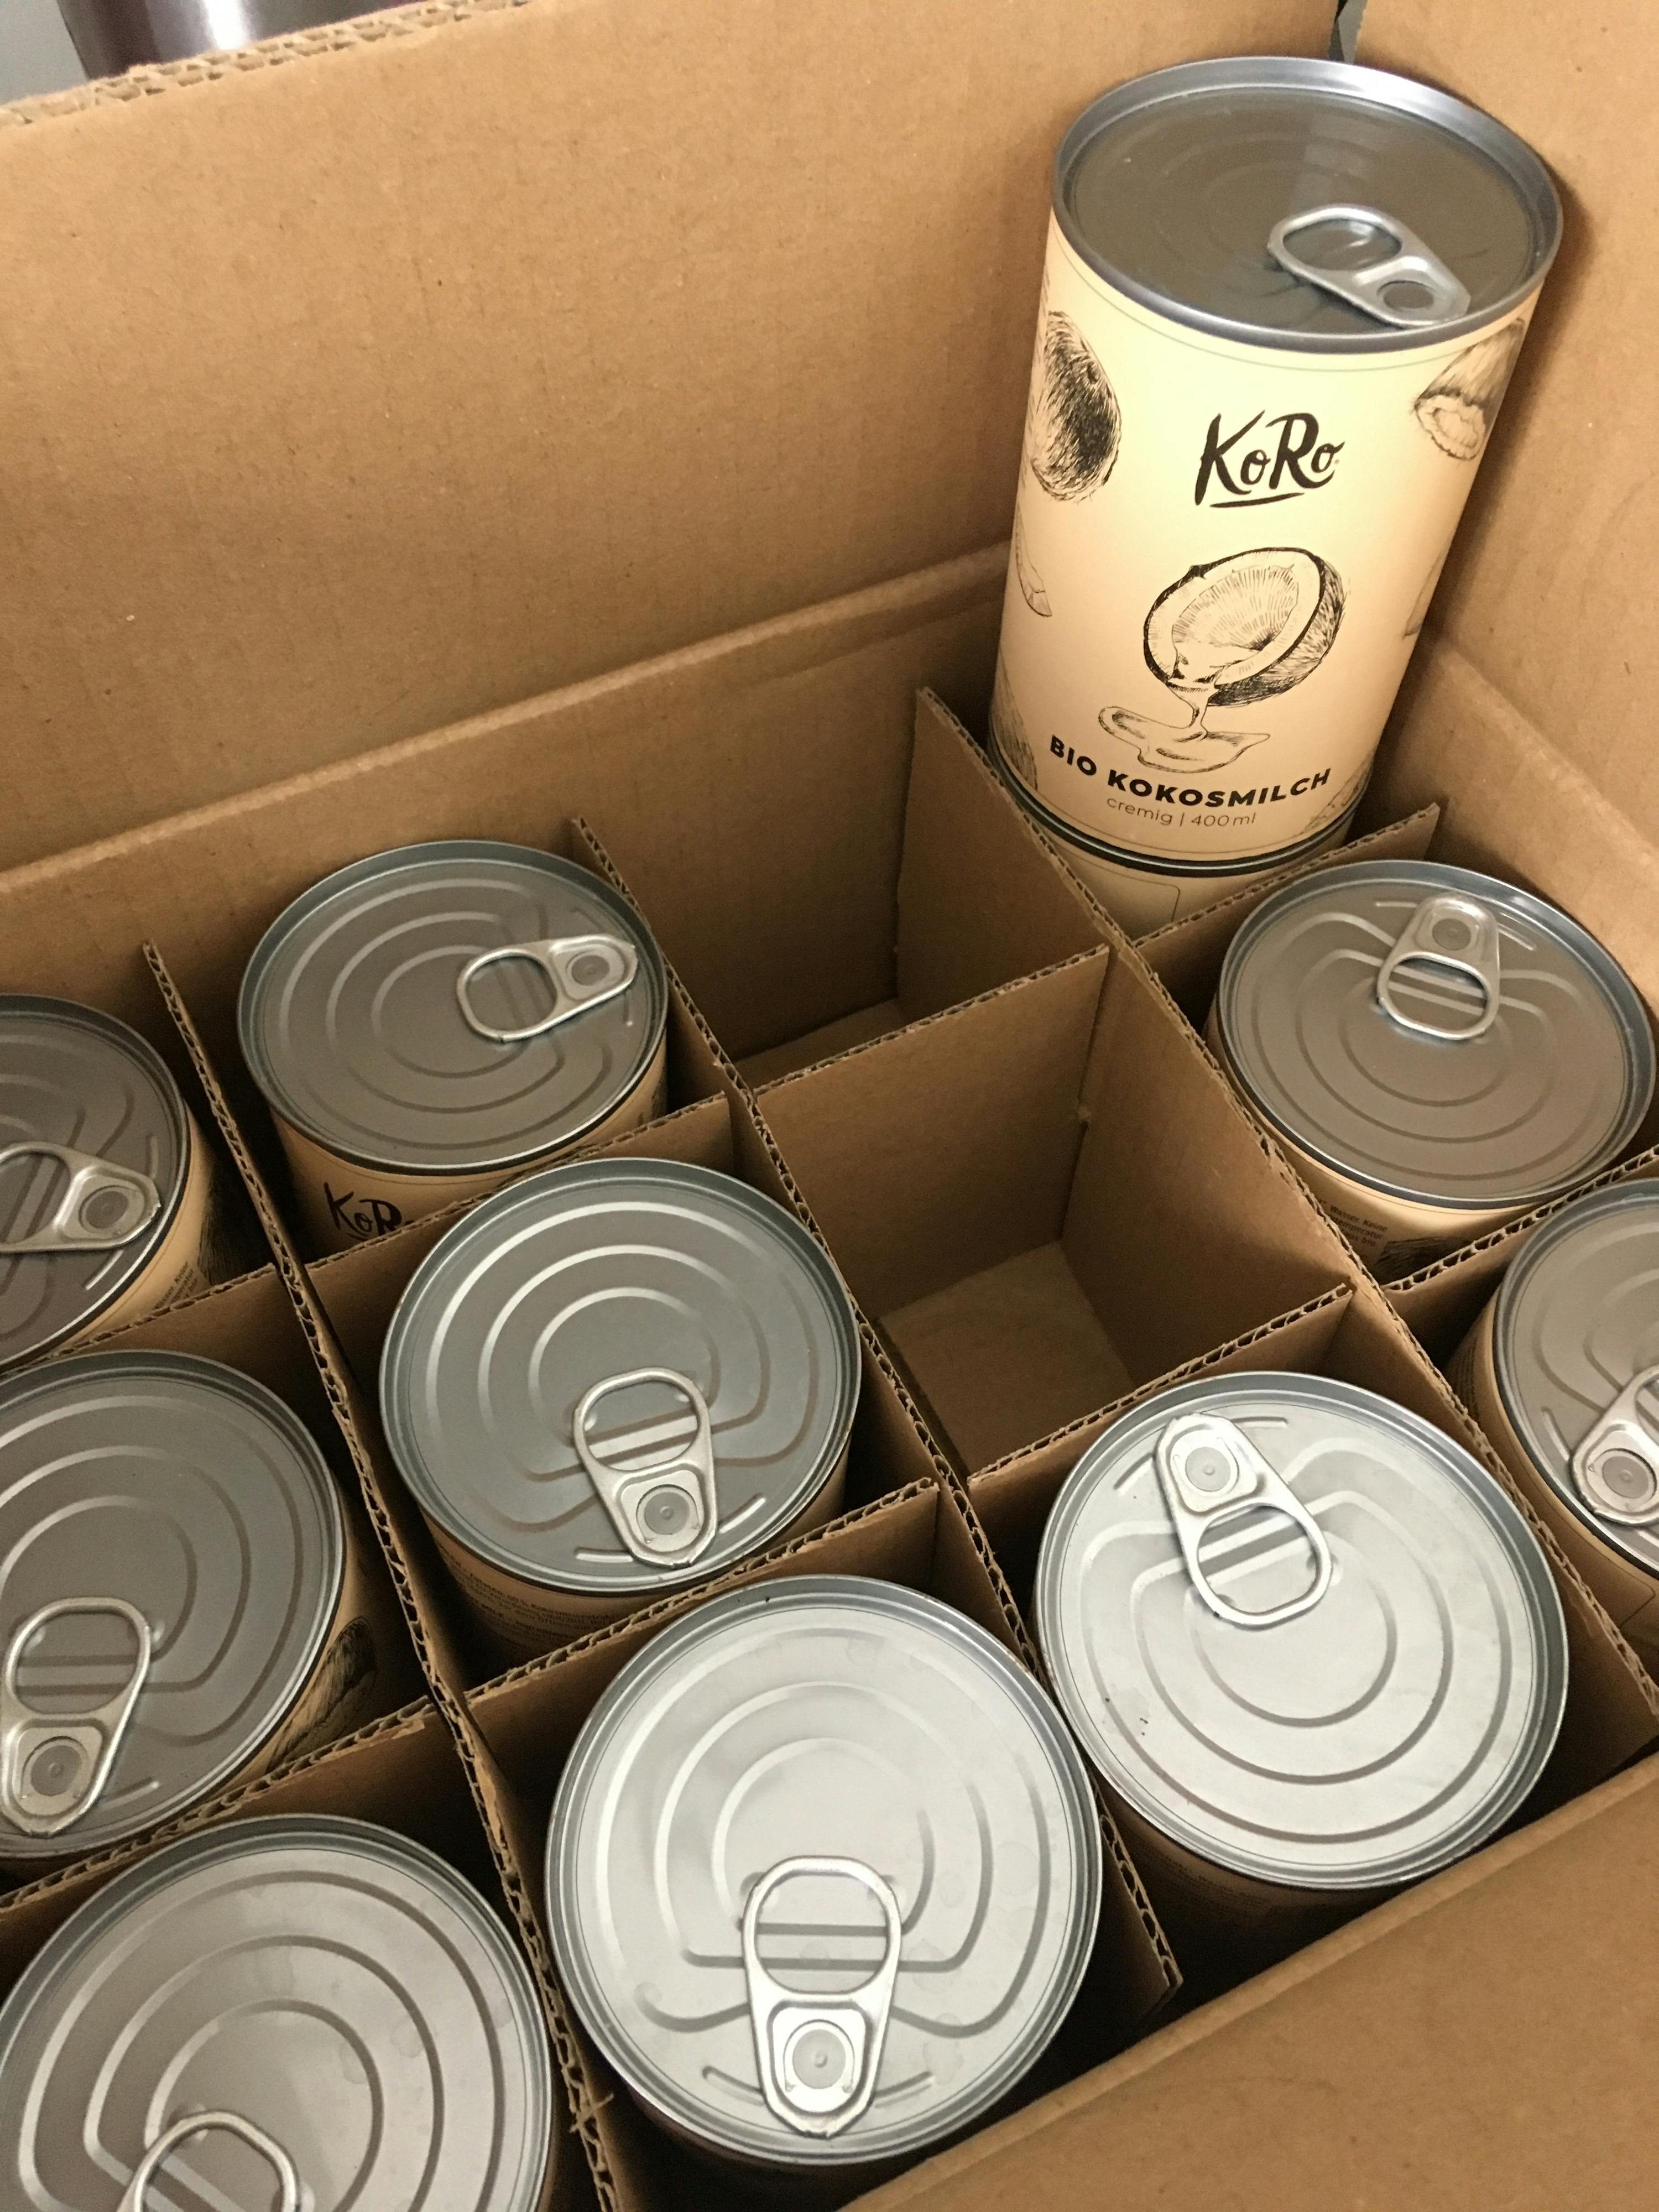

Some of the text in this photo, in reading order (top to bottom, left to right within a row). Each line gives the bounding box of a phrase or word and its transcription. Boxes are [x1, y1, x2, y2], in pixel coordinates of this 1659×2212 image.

[1195, 409, 1345, 508] KoRo
[1050, 735, 1332, 807] BIO KOKOSMILCH
[1107, 797, 1173, 826] cremig
[324, 1182, 415, 1241] KoR
